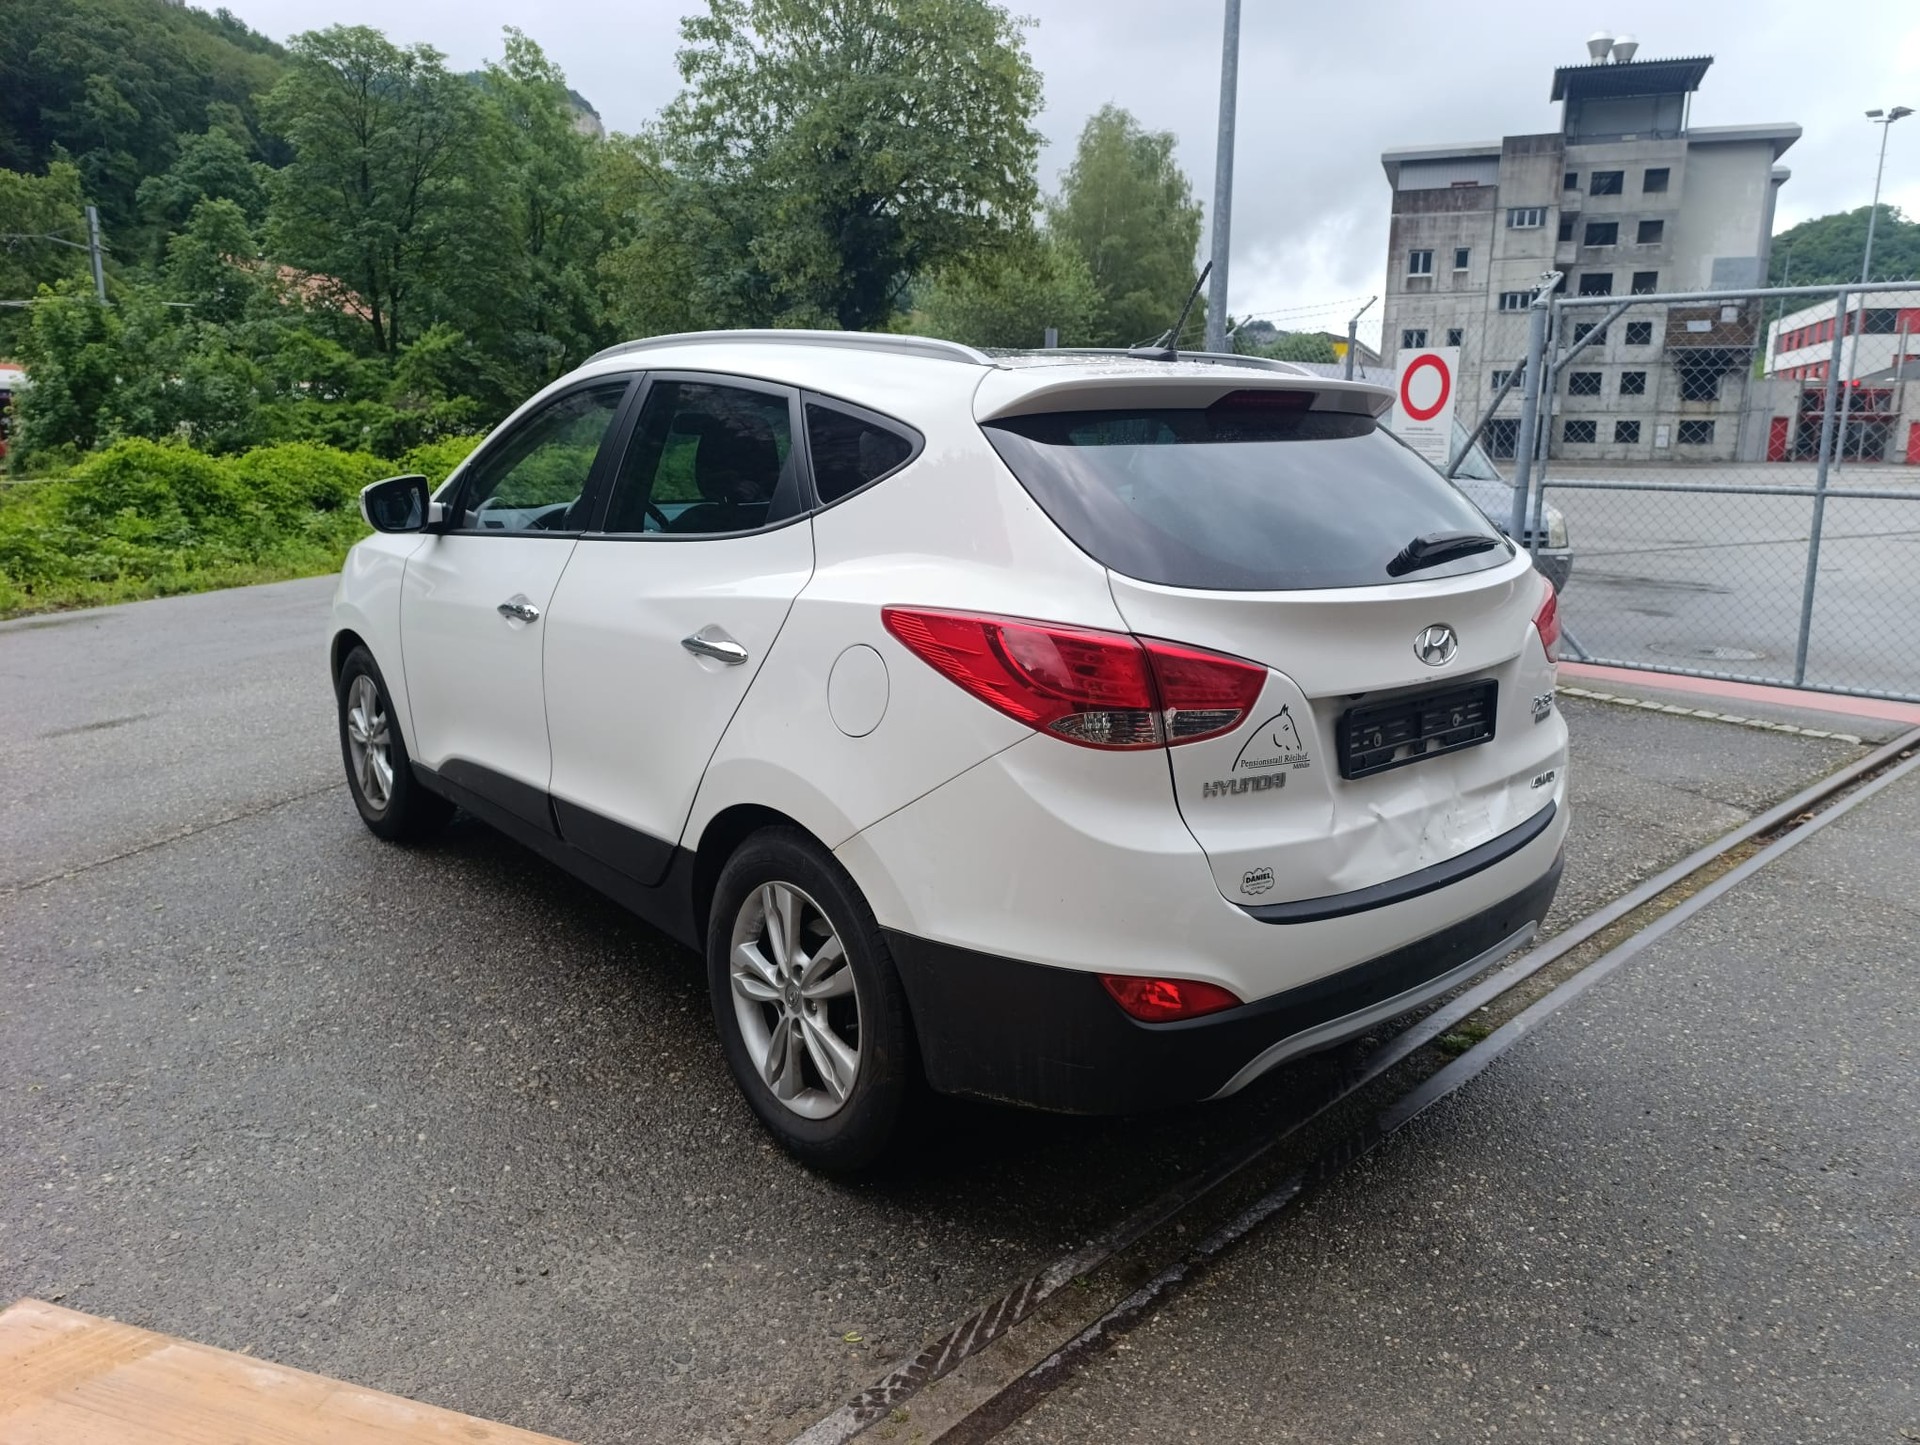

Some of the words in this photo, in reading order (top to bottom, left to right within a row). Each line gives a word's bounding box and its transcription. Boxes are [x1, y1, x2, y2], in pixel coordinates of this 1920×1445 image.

[1240, 755, 1283, 768] Pensionsstall
[1203, 772, 1287, 798] HYUNDAI
[1245, 872, 1271, 884] DANIEL
